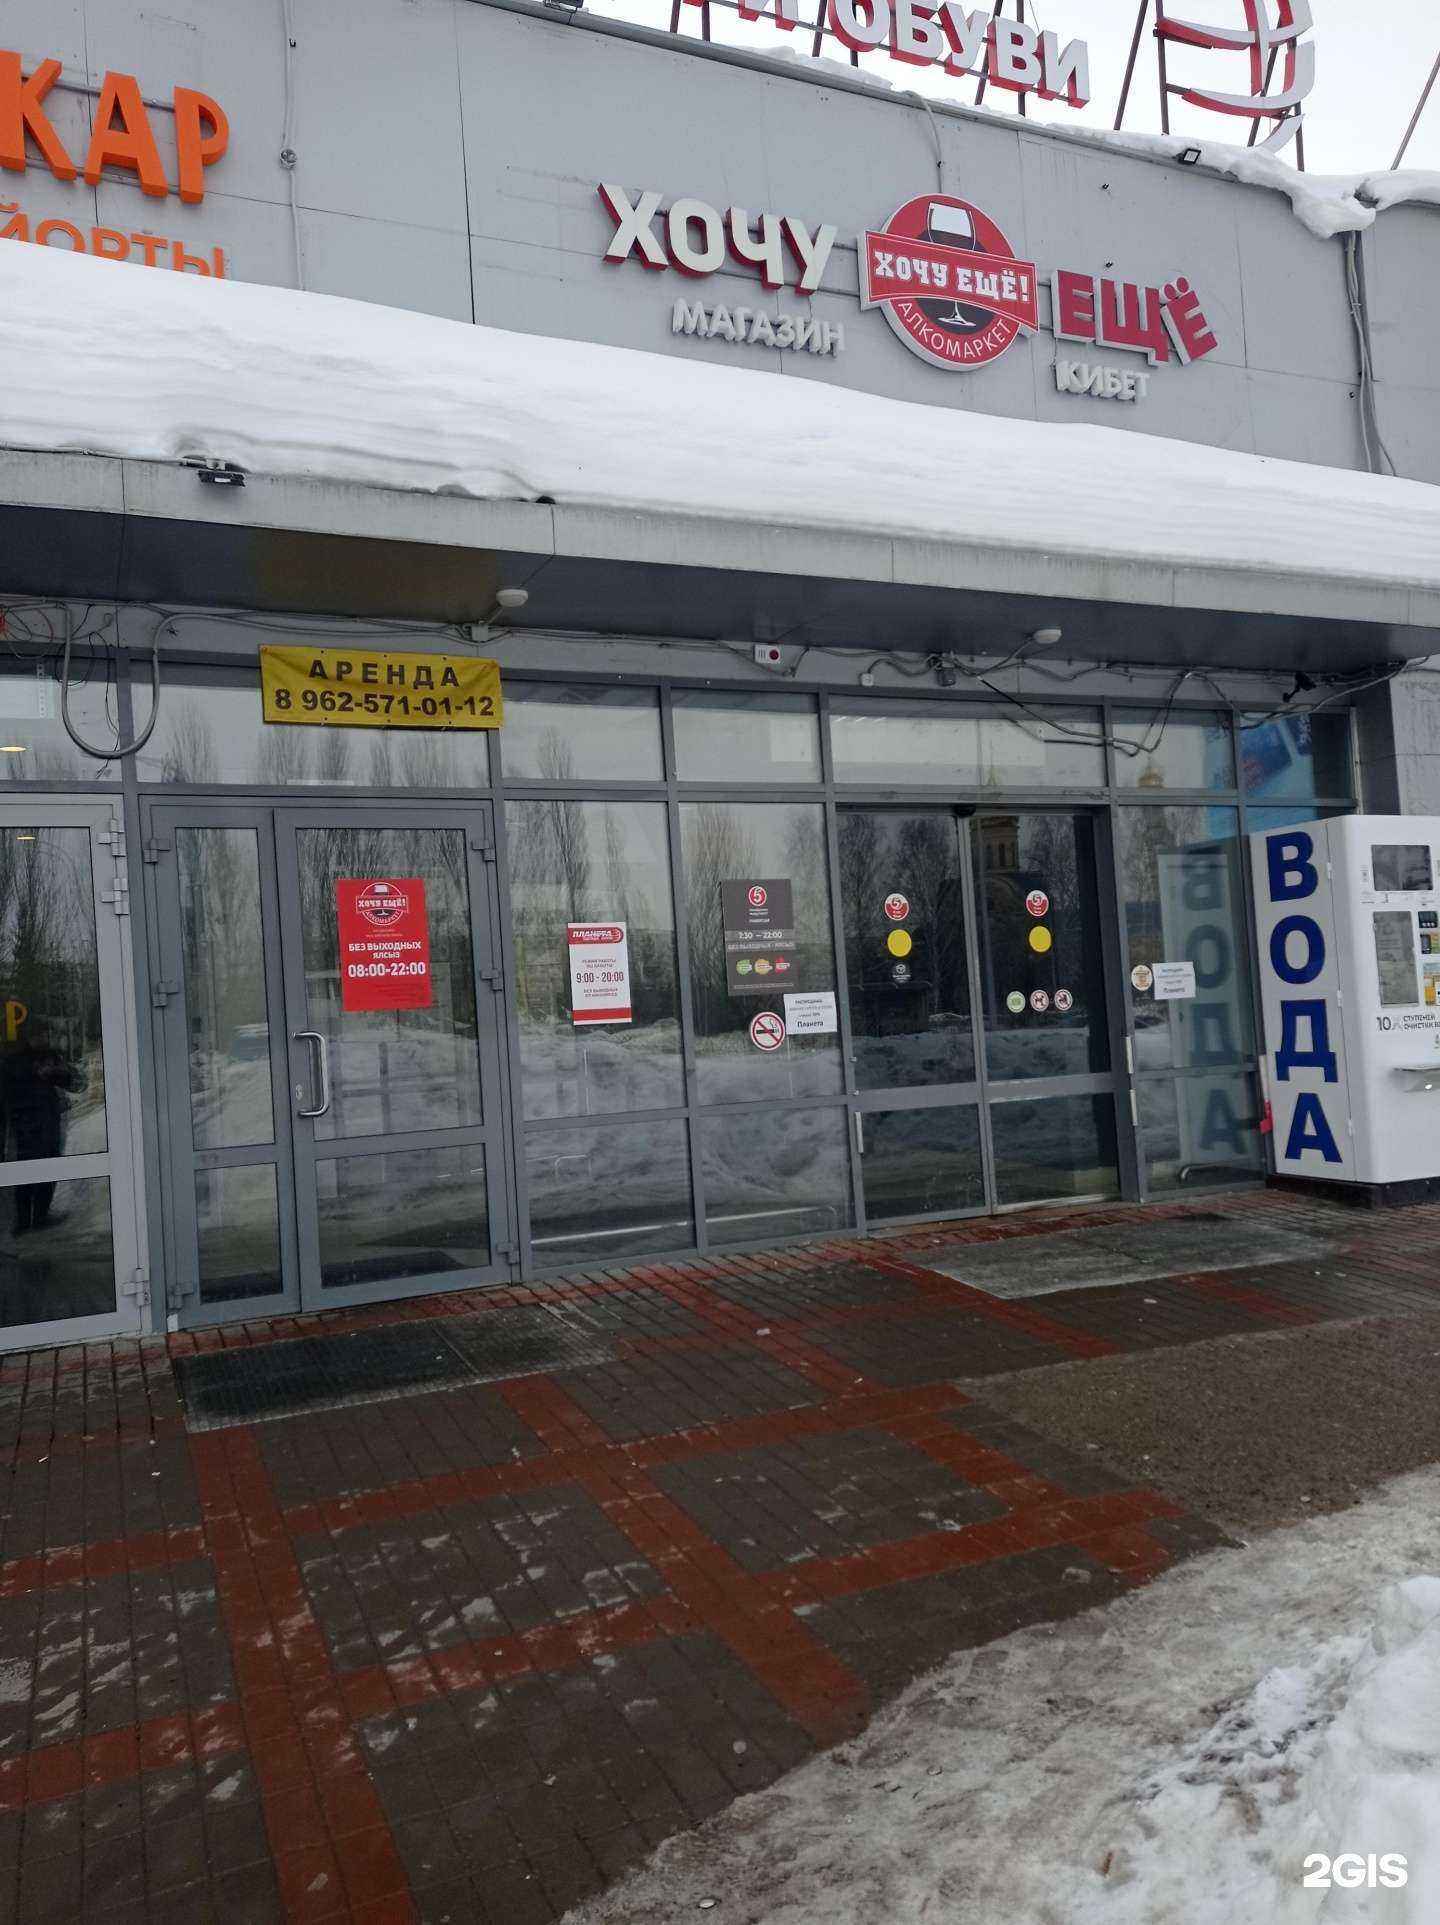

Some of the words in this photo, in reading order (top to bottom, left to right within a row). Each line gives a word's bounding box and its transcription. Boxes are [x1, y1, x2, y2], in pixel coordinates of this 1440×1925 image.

[828, 0, 1090, 109] ОБУВИ
[0, 49, 229, 204] КАР
[598, 183, 838, 296] ХОЧУ
[874, 250, 948, 288] ХОЧУ
[956, 268, 1029, 302] ЕЩЁ!
[672, 299, 846, 357] МАГАЗИН
[898, 301, 1011, 359] АЛКОМАРКЕТ
[1052, 275, 1218, 366] ЕЩЁ
[1055, 361, 1150, 402] КИБЕТ
[275, 688, 292, 710] 8
[301, 689, 494, 717] 962-571-01-12
[308, 660, 460, 690] АРЕНДА
[347, 962, 426, 978] 08:00-22:00
[348, 943, 366, 952] БЕЗ
[367, 941, 422, 951] ВЫХОДНЫХ
[1265, 830, 1343, 1164] ВОДА
[1376, 1016, 1392, 1031] 10
